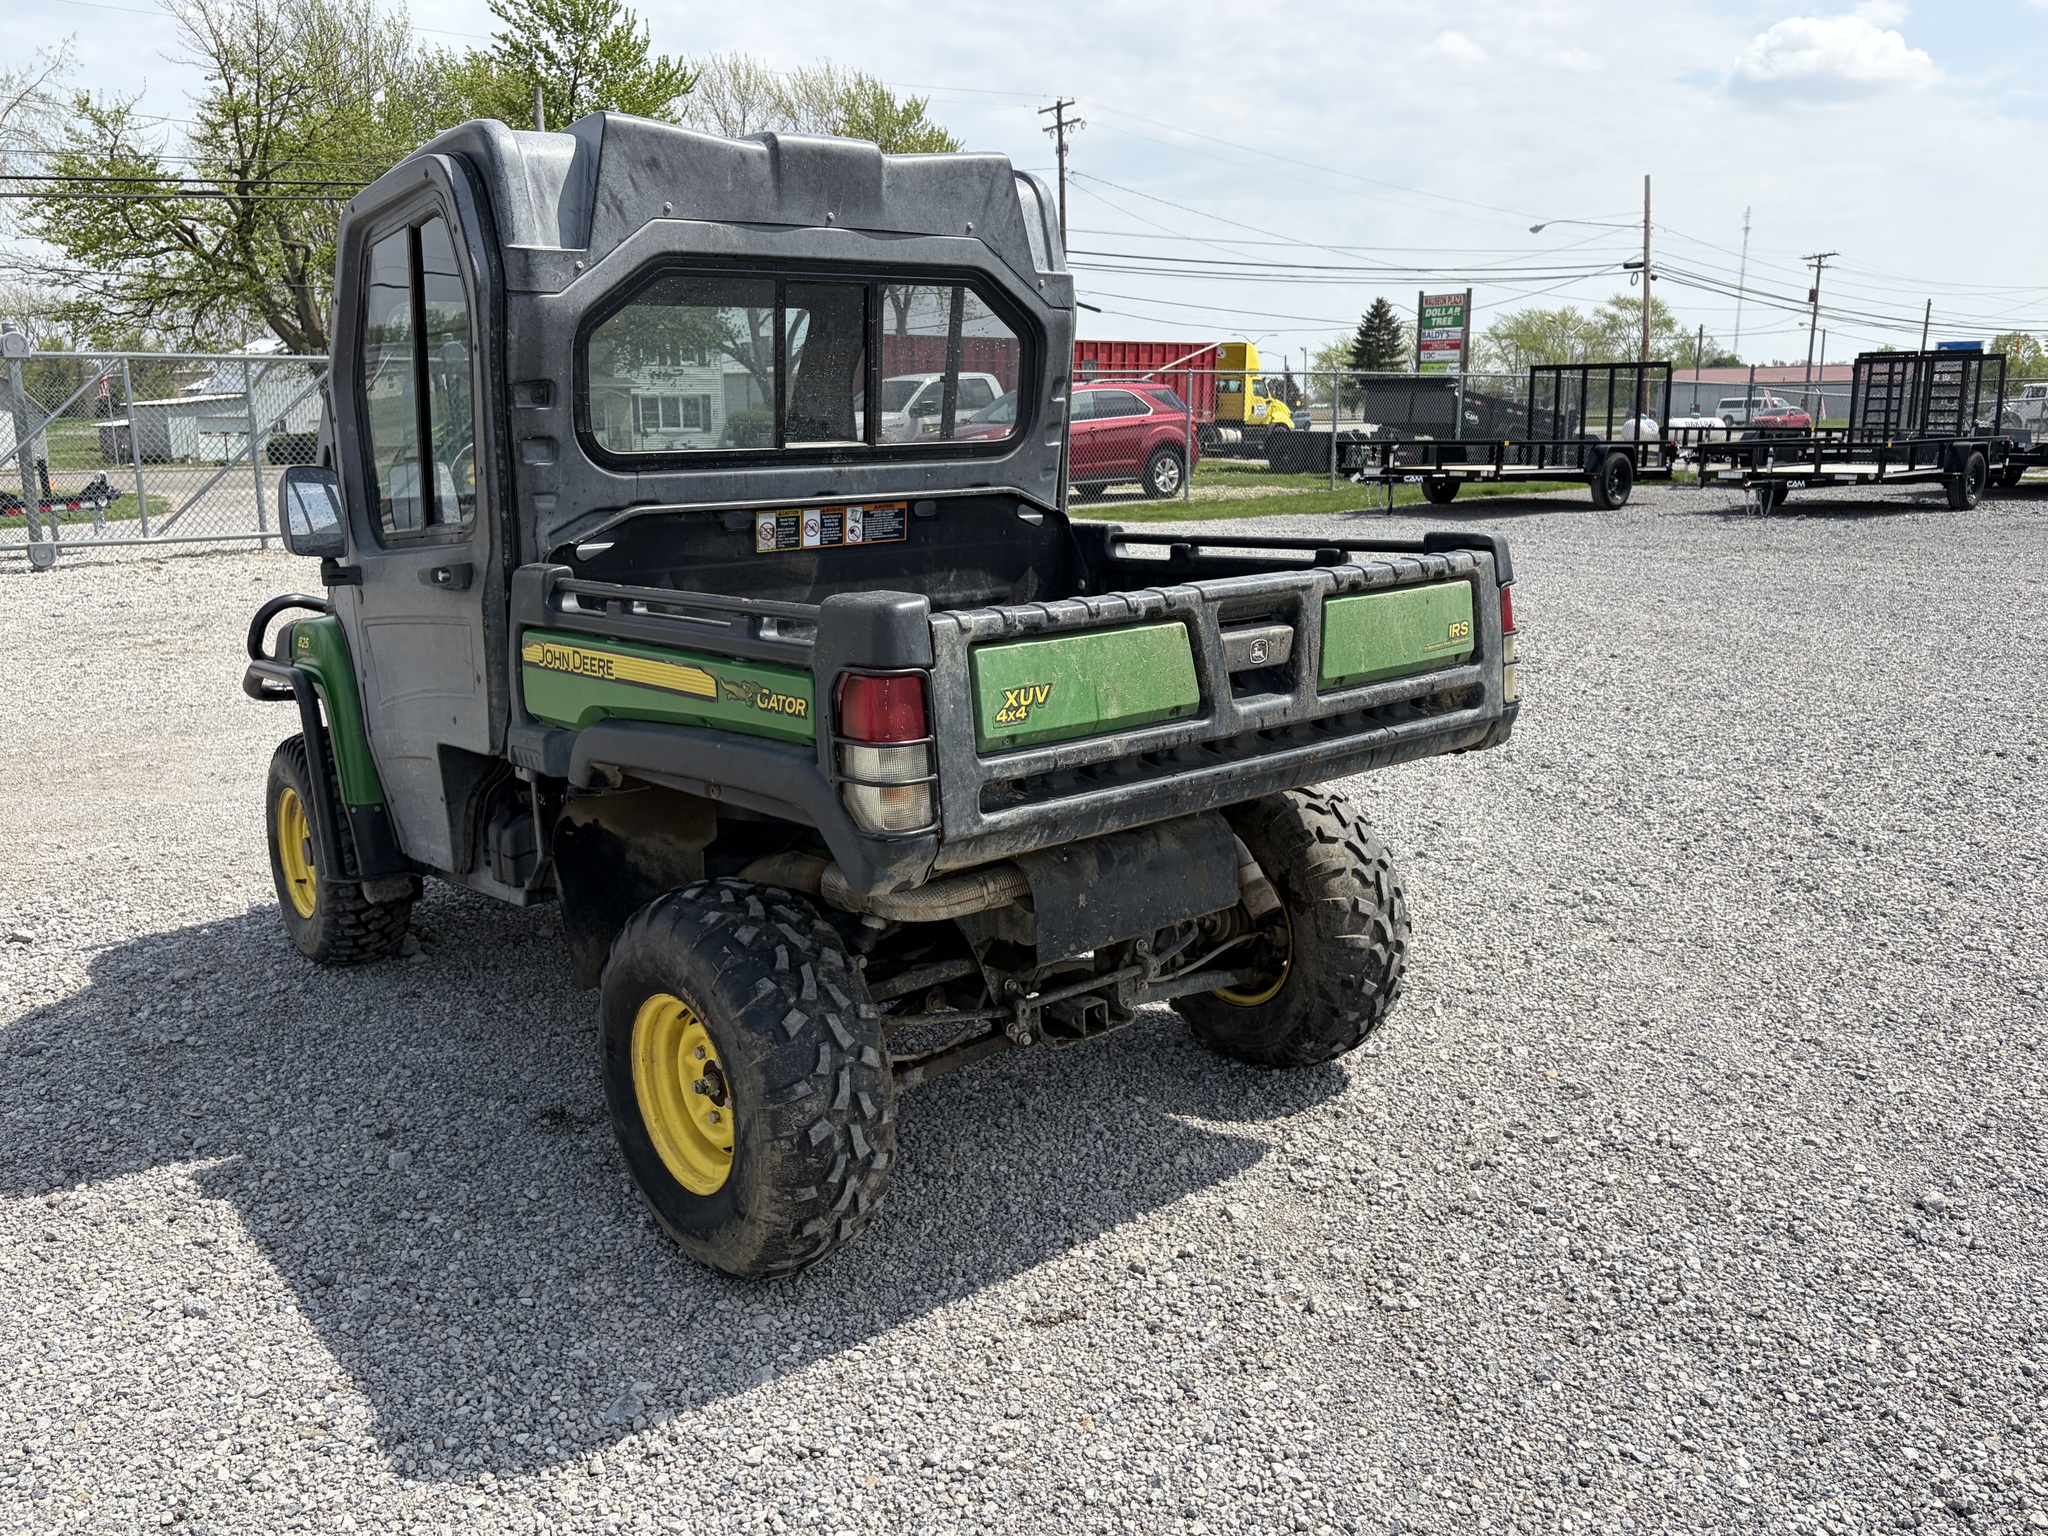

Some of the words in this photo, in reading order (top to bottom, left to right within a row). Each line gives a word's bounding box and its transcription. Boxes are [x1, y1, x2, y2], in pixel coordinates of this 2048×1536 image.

[1425, 307, 1461, 317] DOLLAR
[1431, 317, 1454, 326] TREE
[1403, 475, 1424, 483] CAM
[1786, 480, 1806, 488] CAM
[1448, 621, 1470, 639] IRS
[298, 637, 310, 649] 825
[539, 643, 571, 670] JOHN
[572, 649, 615, 678] DEERE
[757, 688, 807, 717] GATOR
[1003, 684, 1051, 709] XUV
[996, 706, 1027, 722] 4x4
